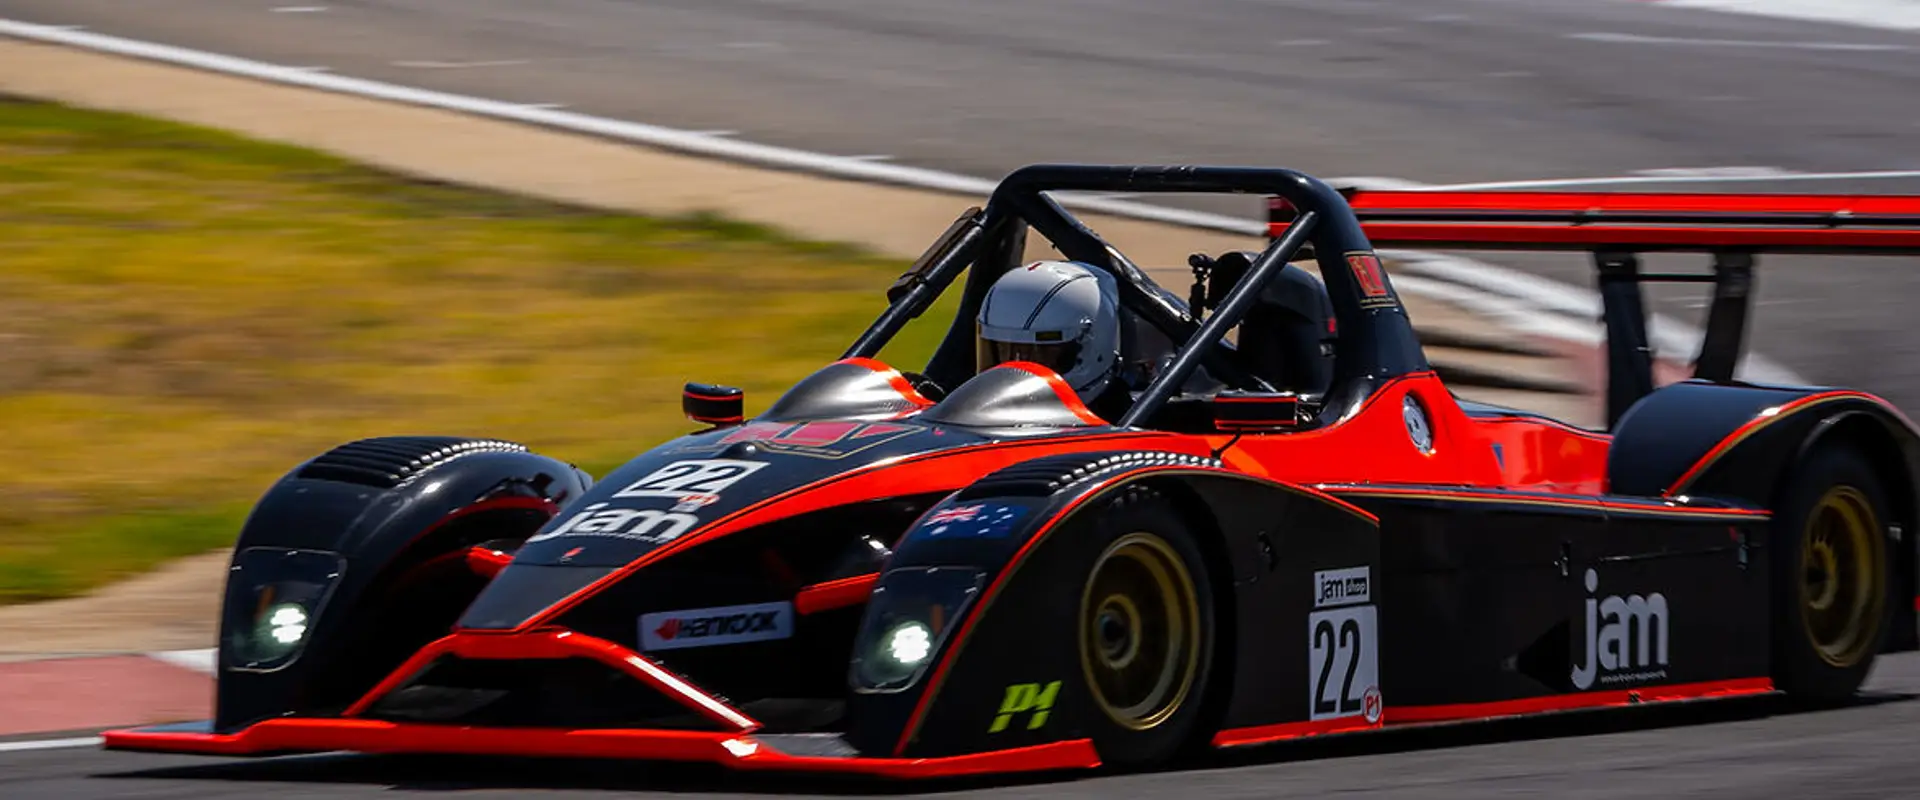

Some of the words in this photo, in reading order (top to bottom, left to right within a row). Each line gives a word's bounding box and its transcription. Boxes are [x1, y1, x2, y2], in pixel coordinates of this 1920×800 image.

[629, 464, 747, 492] 22
[526, 503, 699, 542] jam
[1318, 574, 1343, 603] jam
[1571, 568, 1668, 690] jam
[1314, 618, 1361, 713] 22
